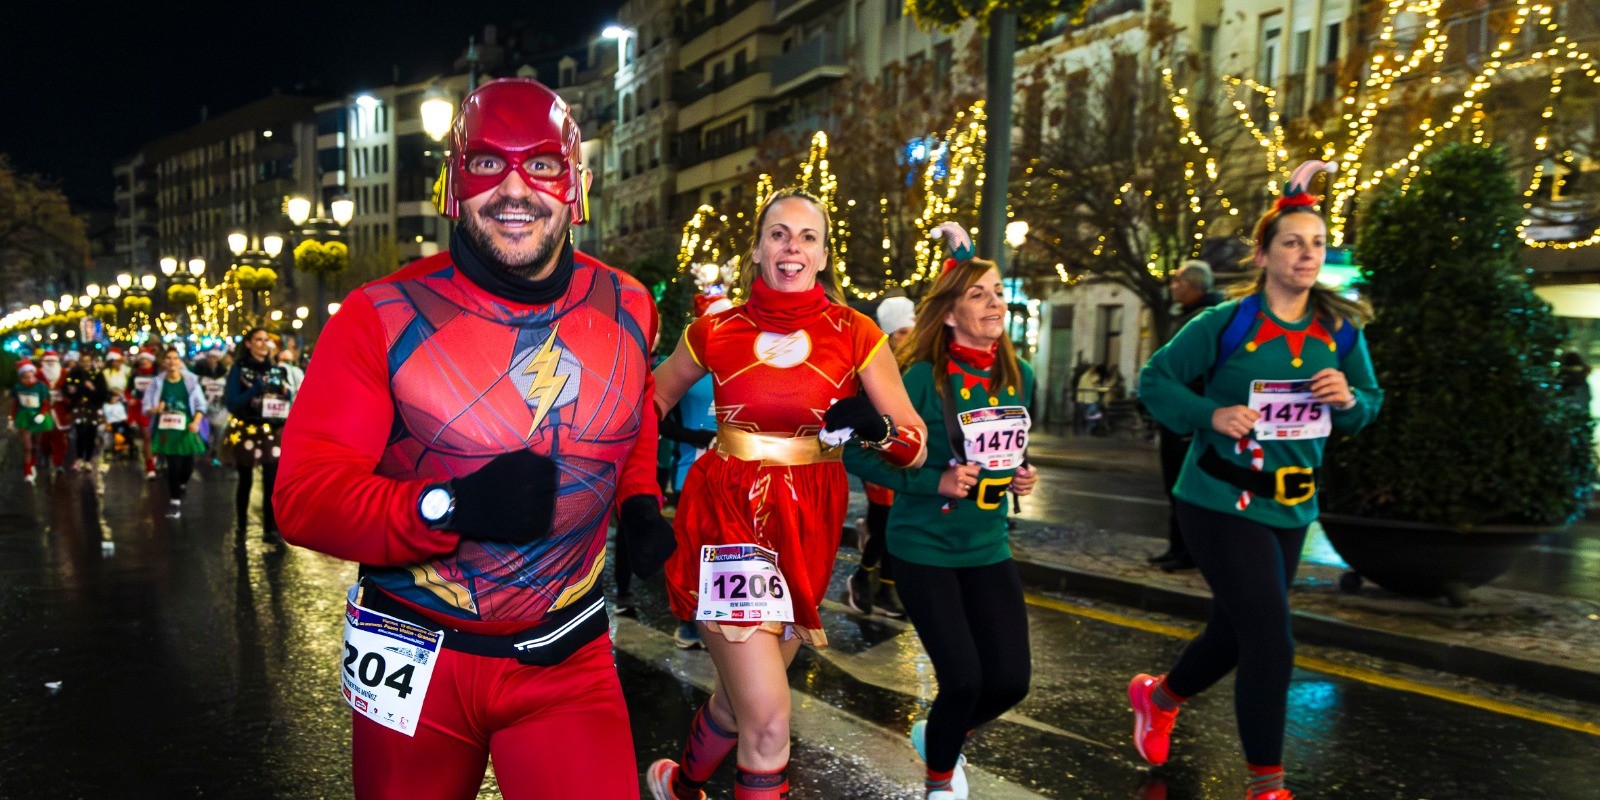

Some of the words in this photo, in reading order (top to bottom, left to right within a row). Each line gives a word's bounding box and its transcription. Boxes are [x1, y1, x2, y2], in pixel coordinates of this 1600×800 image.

[1260, 402, 1322, 422] 1475
[976, 429, 1026, 453] 1476
[704, 547, 717, 562] 33
[715, 553, 741, 561] NOCTURNA
[713, 574, 784, 599] 1206
